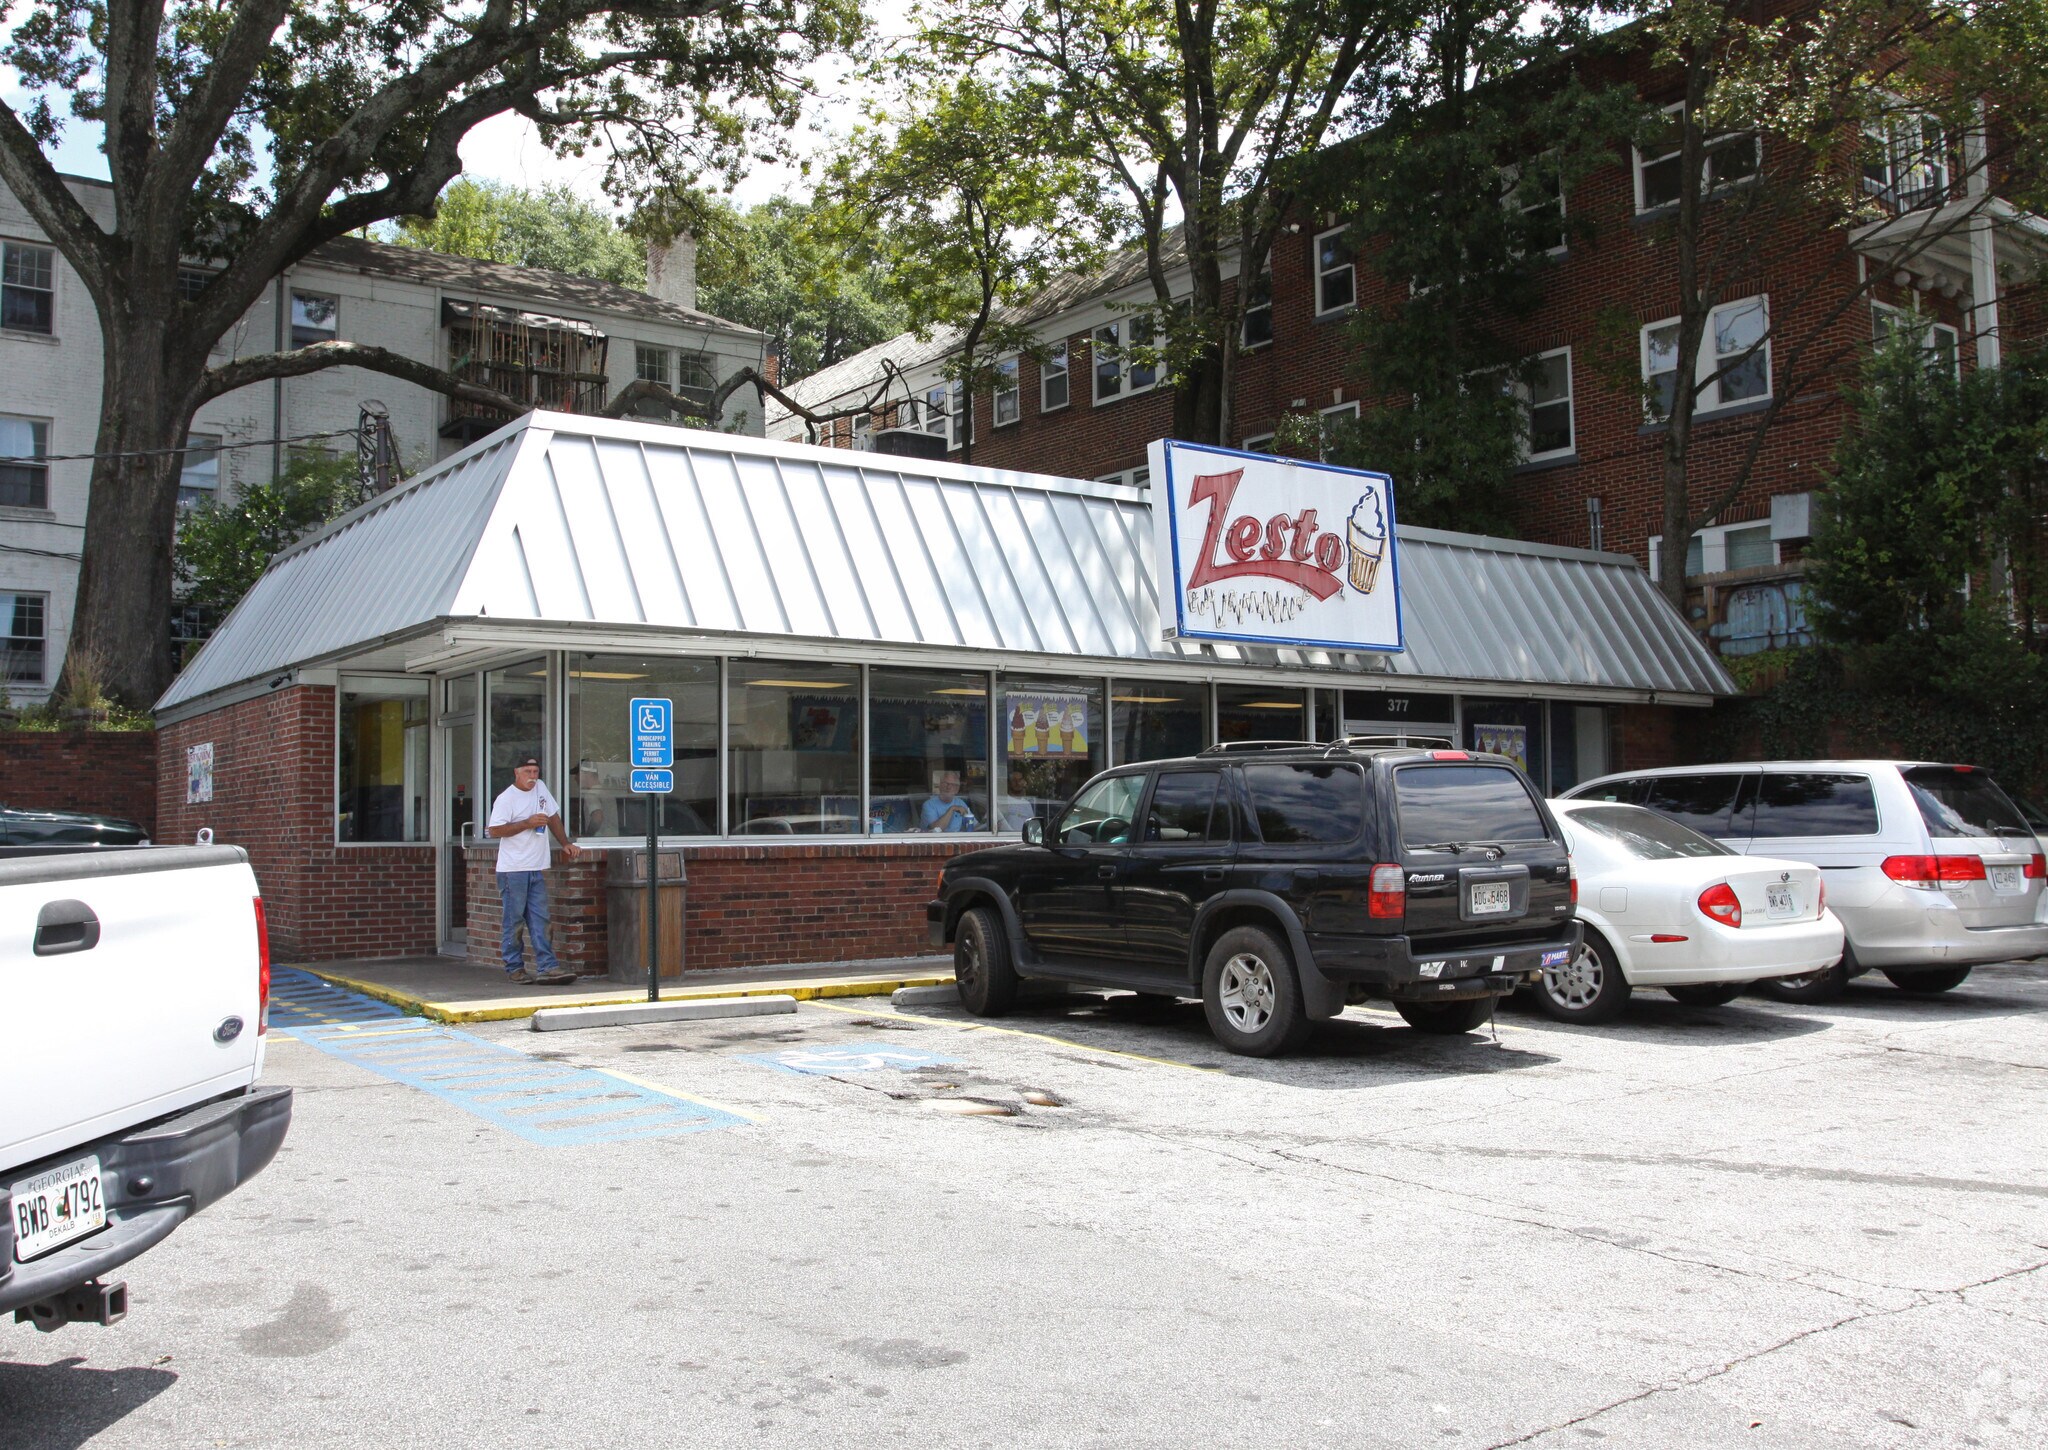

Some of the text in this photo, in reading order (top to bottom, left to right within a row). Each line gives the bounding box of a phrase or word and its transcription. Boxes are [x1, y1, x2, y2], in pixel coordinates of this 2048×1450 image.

[1186, 466, 1346, 602] Zesto
[1387, 699, 1409, 712] 377
[33, 1165, 81, 1193] GEORGIA
[18, 1176, 101, 1240] BWB 4792
[48, 1220, 75, 1239] DEKALB
